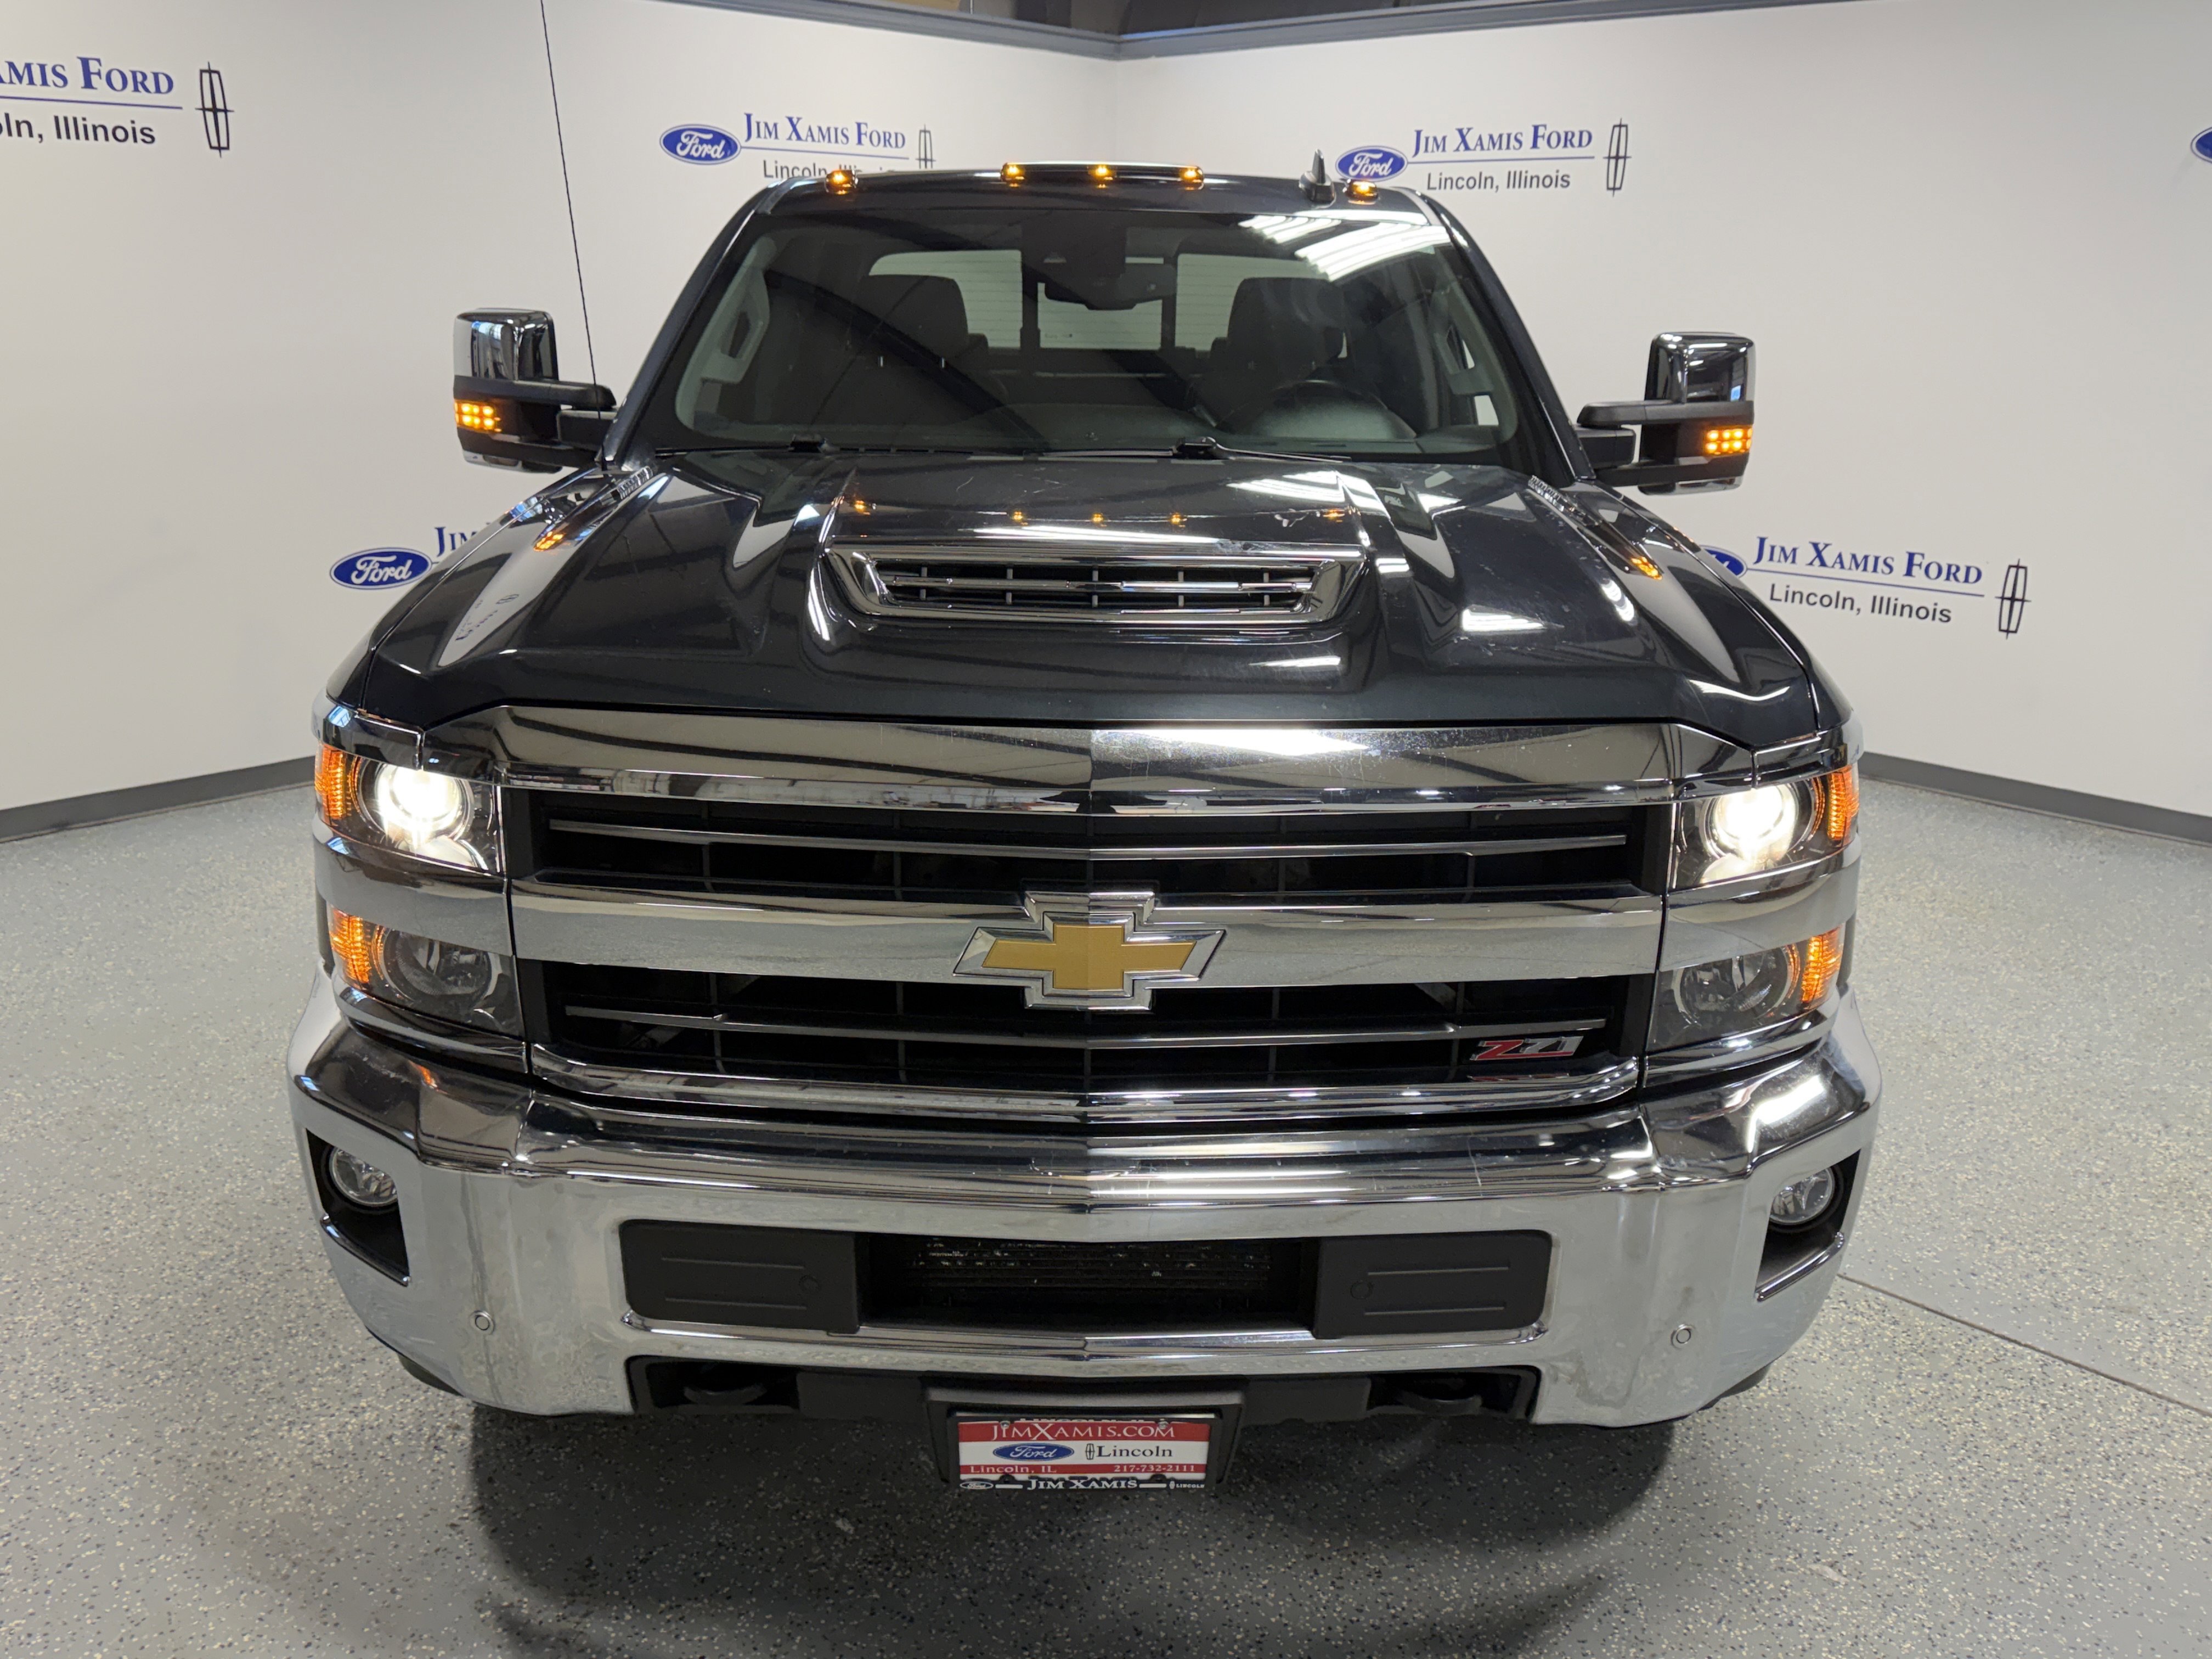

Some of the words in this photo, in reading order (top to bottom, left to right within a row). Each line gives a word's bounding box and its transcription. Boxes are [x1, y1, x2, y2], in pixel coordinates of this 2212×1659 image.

[76, 57, 173, 94] FORD
[54, 115, 155, 144] Illinois
[744, 112, 778, 143] JIM
[785, 116, 849, 145] XAMIS
[855, 122, 906, 149] FORD
[1412, 129, 1447, 158] JIM
[1453, 127, 1523, 153] XAMIS
[1530, 124, 1592, 150] FORD
[676, 131, 726, 158] Ford
[1348, 153, 1393, 176] Ford
[1426, 171, 1499, 193] Lincoln,
[1506, 170, 1571, 189] Illinois
[351, 555, 412, 584] Ford
[1753, 536, 1798, 565] JIM
[1806, 541, 1894, 574] XAMIS
[1903, 551, 1982, 584] FORD
[1770, 584, 1861, 616] Lincoln,
[1871, 595, 1952, 623] Illinois
[1469, 1036, 1584, 1061] Z71
[1010, 1445, 1058, 1458] Ford
[1097, 1445, 1172, 1457] Lincoln
[1027, 1479, 1064, 1490] JIM
[1069, 1479, 1137, 1489] XAMIS
